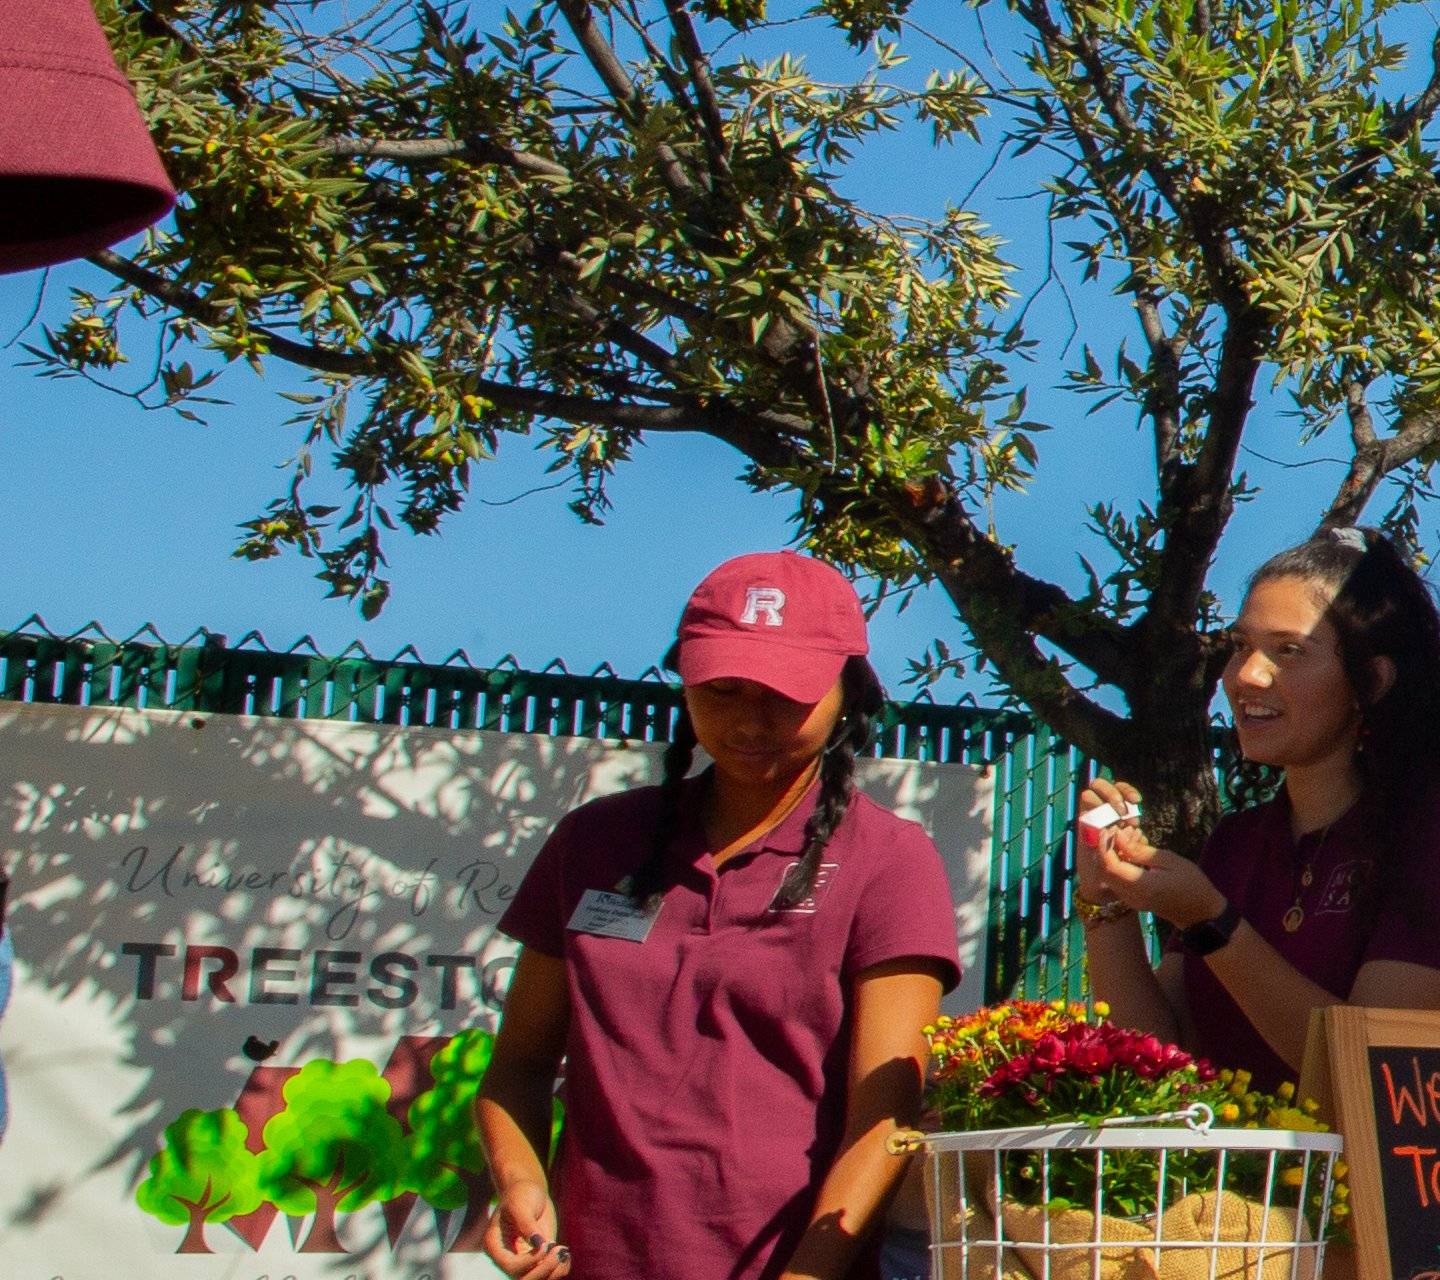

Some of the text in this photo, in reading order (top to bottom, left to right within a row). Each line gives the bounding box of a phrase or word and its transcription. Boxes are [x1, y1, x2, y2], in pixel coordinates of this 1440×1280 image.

[740, 587, 786, 626] R
[121, 845, 378, 941] University
[390, 858, 440, 918] of
